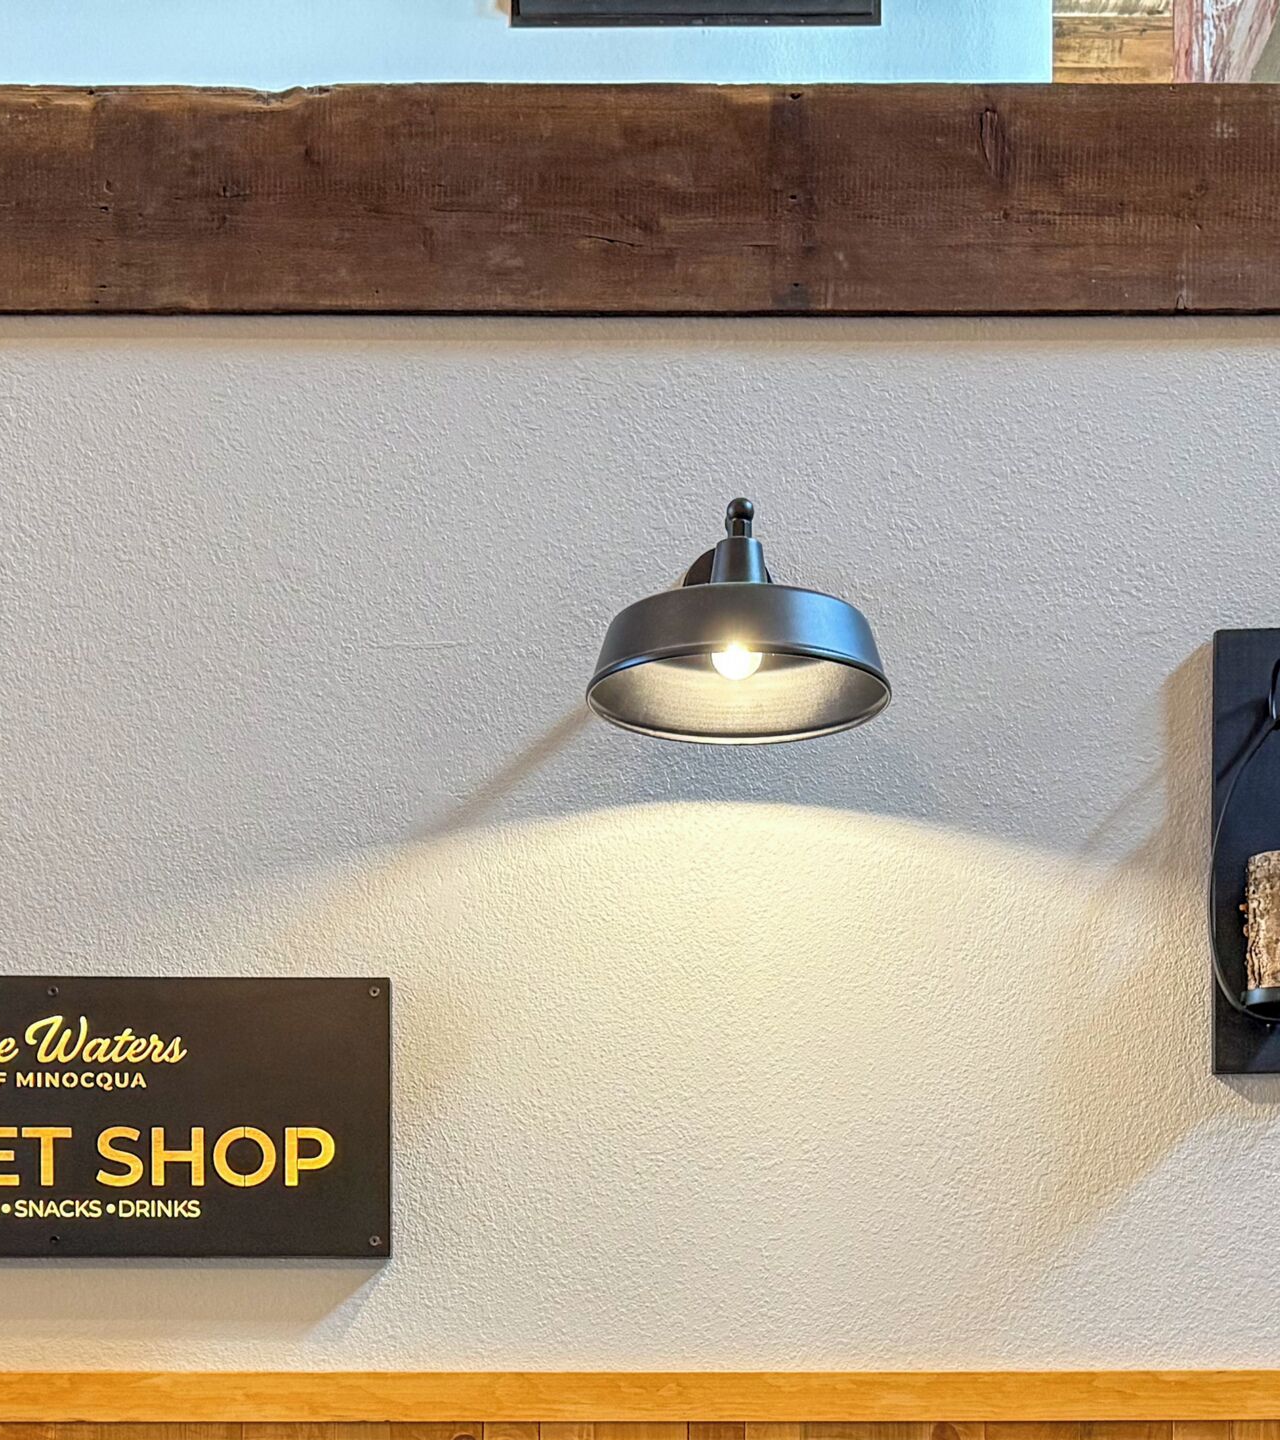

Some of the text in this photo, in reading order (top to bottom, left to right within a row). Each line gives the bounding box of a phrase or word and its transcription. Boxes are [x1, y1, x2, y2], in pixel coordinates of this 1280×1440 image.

[24, 1014, 188, 1064] Waters
[15, 1071, 148, 1092] MINOCQUA
[95, 1125, 337, 1188] SHOP
[14, 1199, 103, 1219] SNACKS
[118, 1199, 201, 1219] DRINKS
